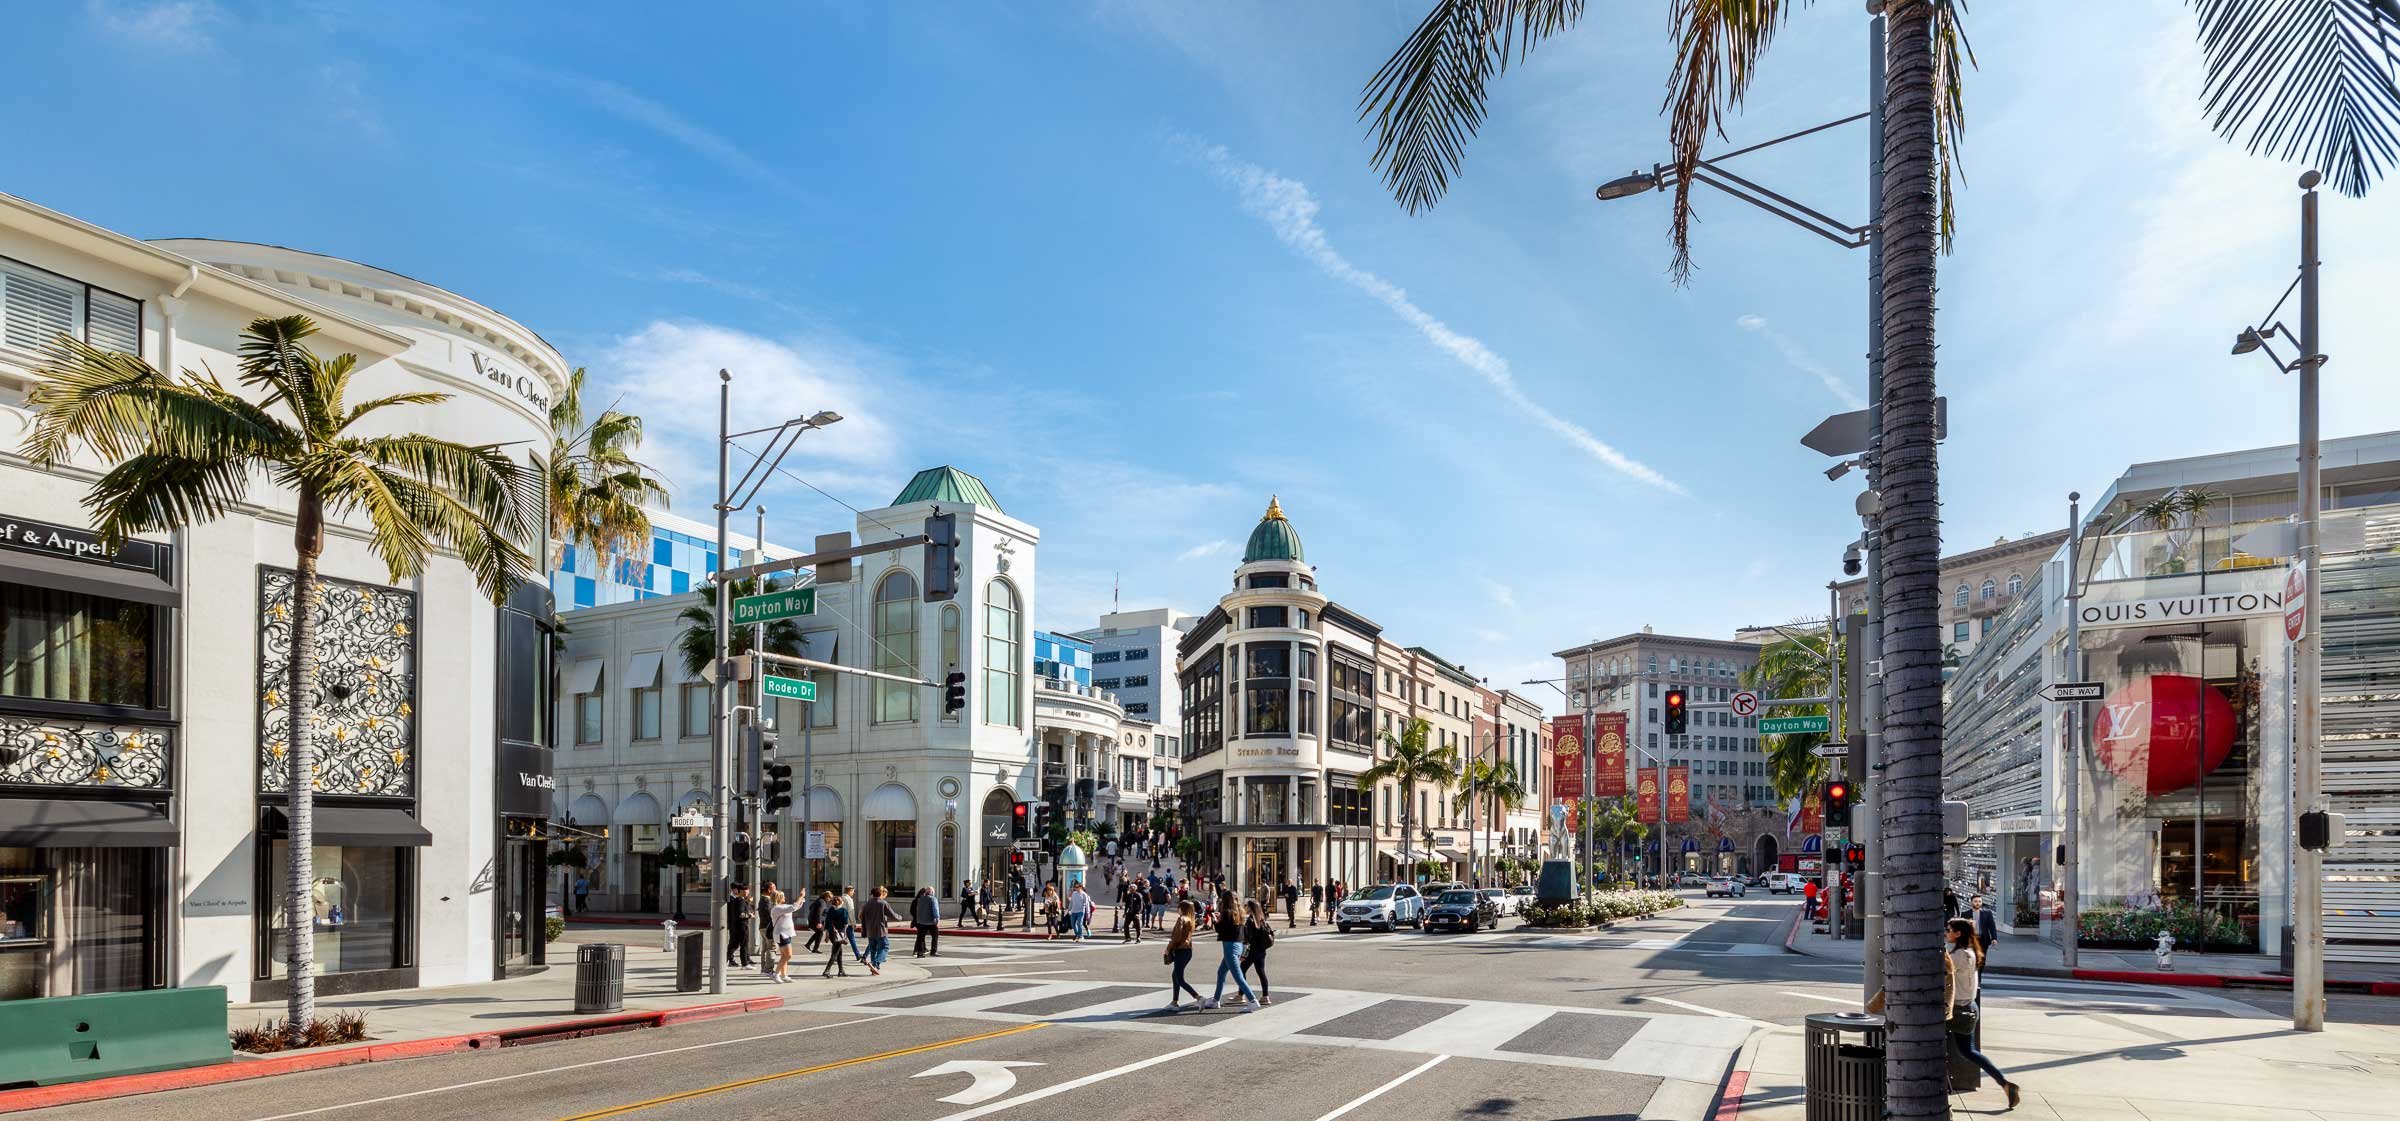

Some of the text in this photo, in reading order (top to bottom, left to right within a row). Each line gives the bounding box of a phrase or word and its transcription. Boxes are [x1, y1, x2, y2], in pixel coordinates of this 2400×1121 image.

[471, 350, 549, 414] Van Cleef
[23, 530, 41, 544] &
[739, 597, 809, 619] Dayton Way
[2078, 592, 2282, 623] OUIS VUITTON
[768, 680, 812, 697] Rodeo Dr
[2057, 687, 2096, 696] ONE WAY
[1763, 720, 1823, 731] Dayton Way
[520, 772, 536, 786] Van
[674, 818, 694, 826] RODEO
